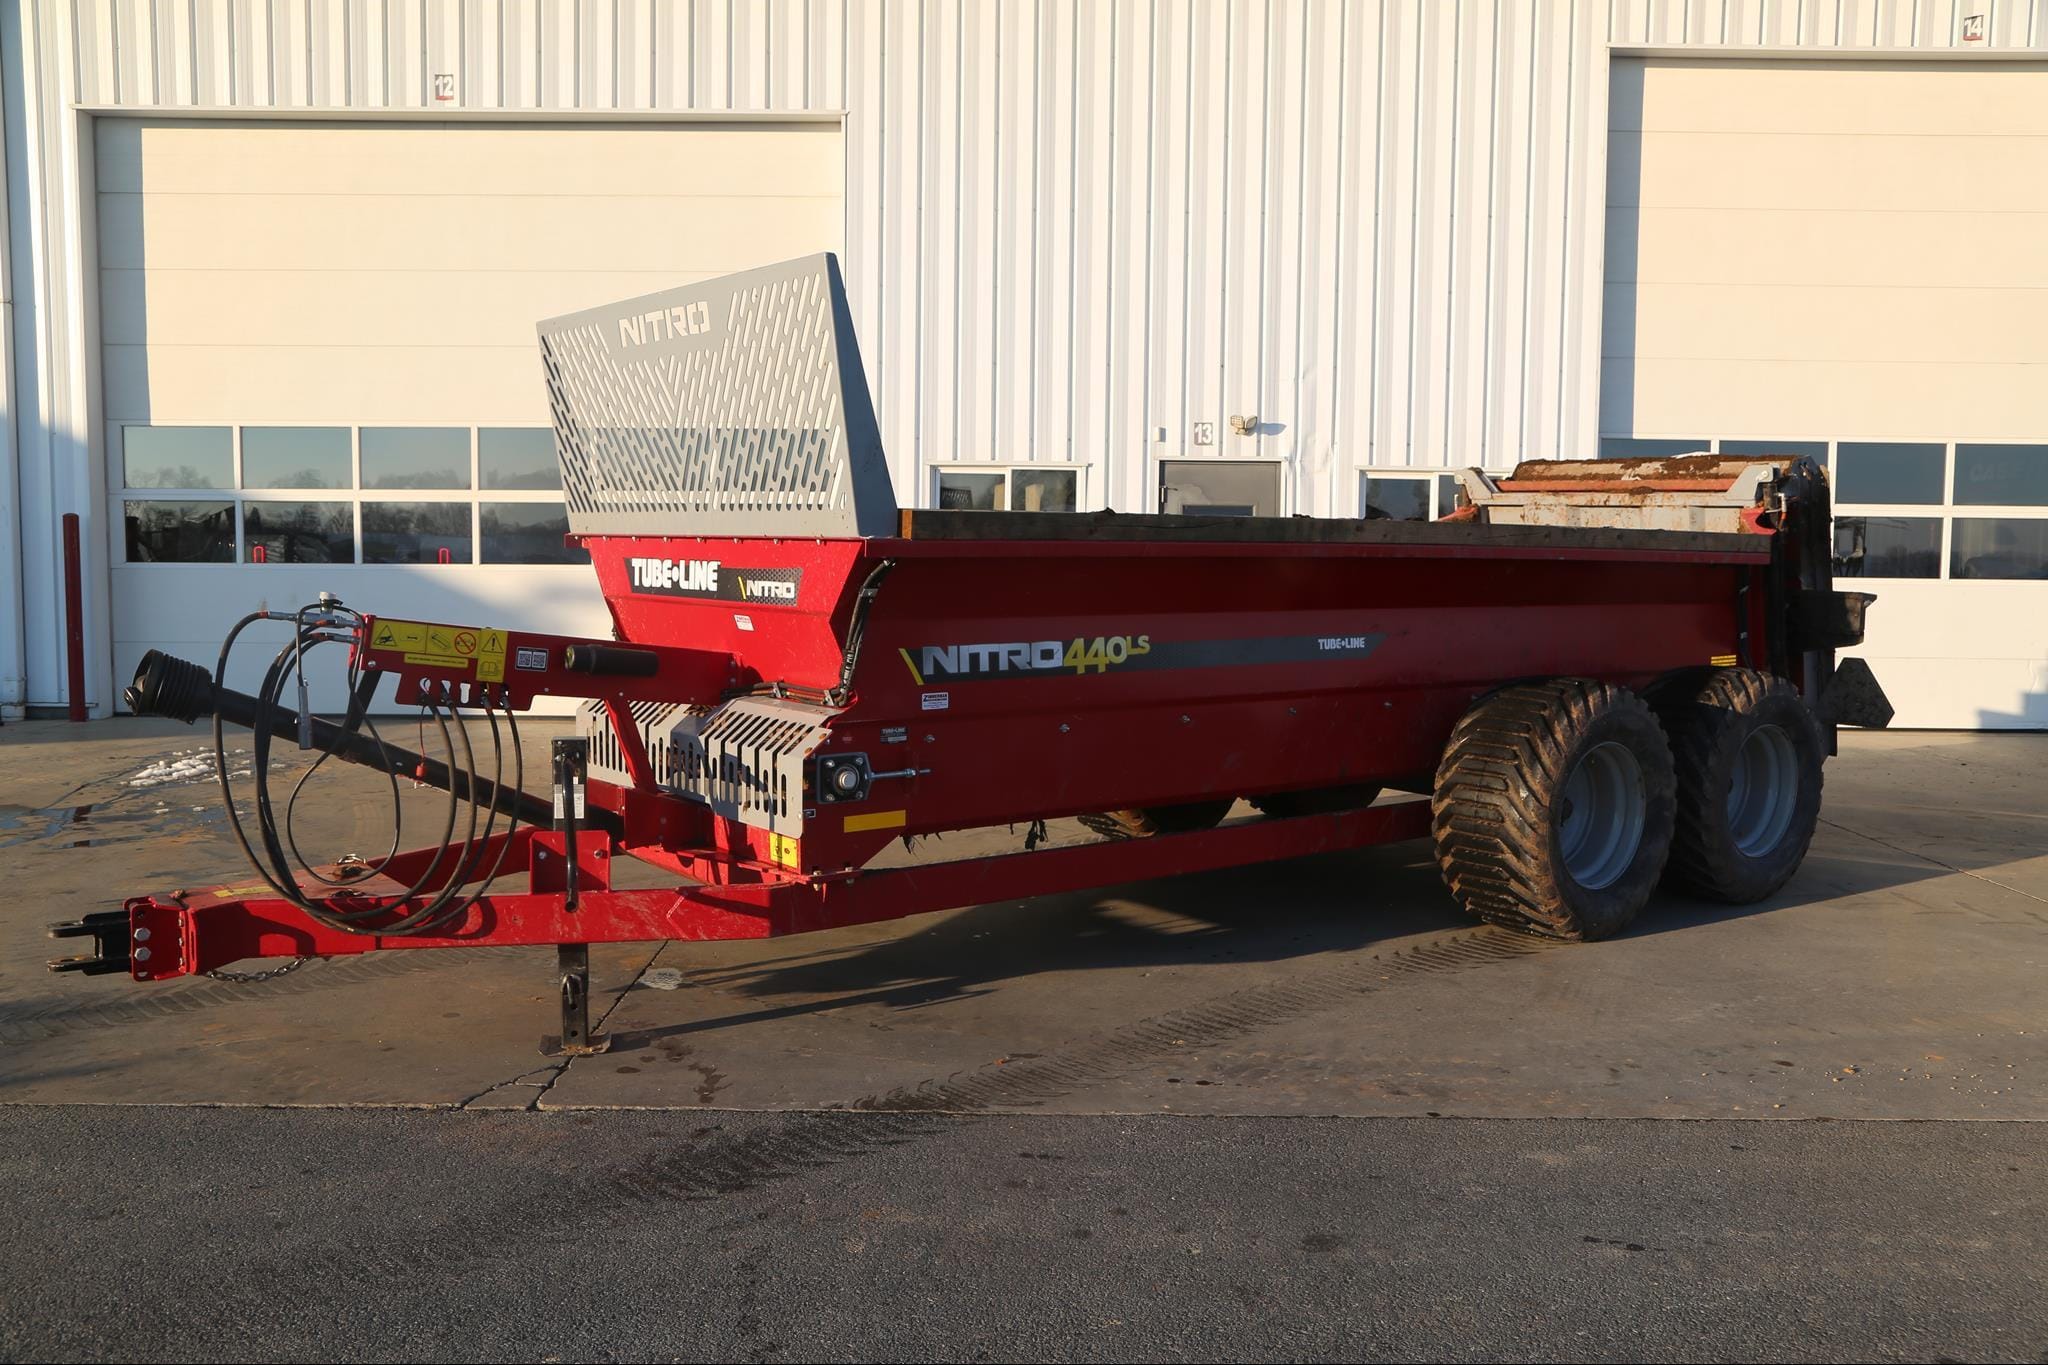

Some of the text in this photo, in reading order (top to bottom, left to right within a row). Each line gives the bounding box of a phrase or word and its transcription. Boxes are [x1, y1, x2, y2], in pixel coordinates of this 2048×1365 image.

[1964, 15, 1984, 37] 14
[435, 75, 453, 97] 12
[618, 301, 711, 349] NITRO
[1194, 423, 1212, 443] 13
[748, 579, 796, 598] NITRO
[922, 641, 1063, 675] NITRO
